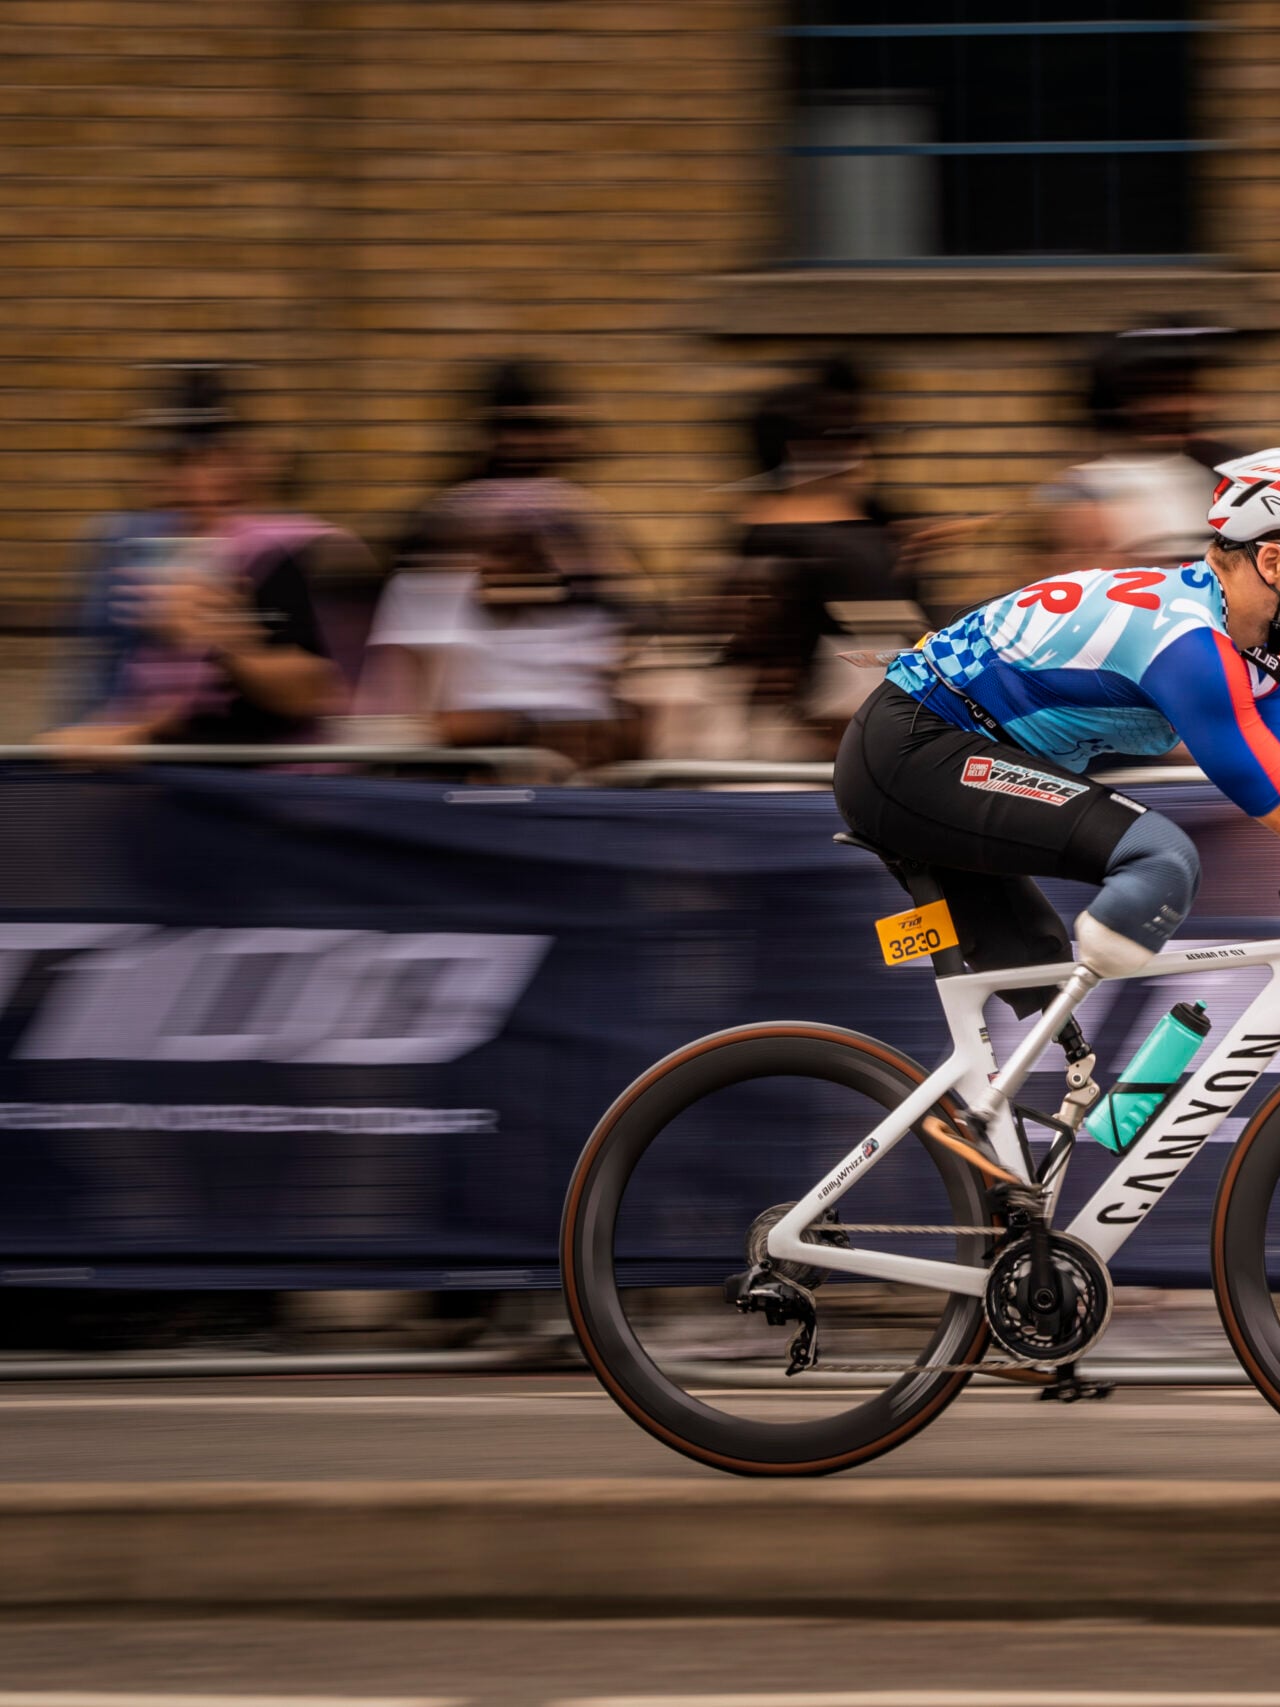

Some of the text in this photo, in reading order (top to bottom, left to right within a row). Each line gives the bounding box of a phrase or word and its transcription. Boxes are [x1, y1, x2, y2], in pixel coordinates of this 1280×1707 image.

[967, 769, 987, 777] RELIEF
[969, 763, 989, 771] COMIC
[999, 770, 1079, 797] RACE
[889, 929, 942, 959] 3230
